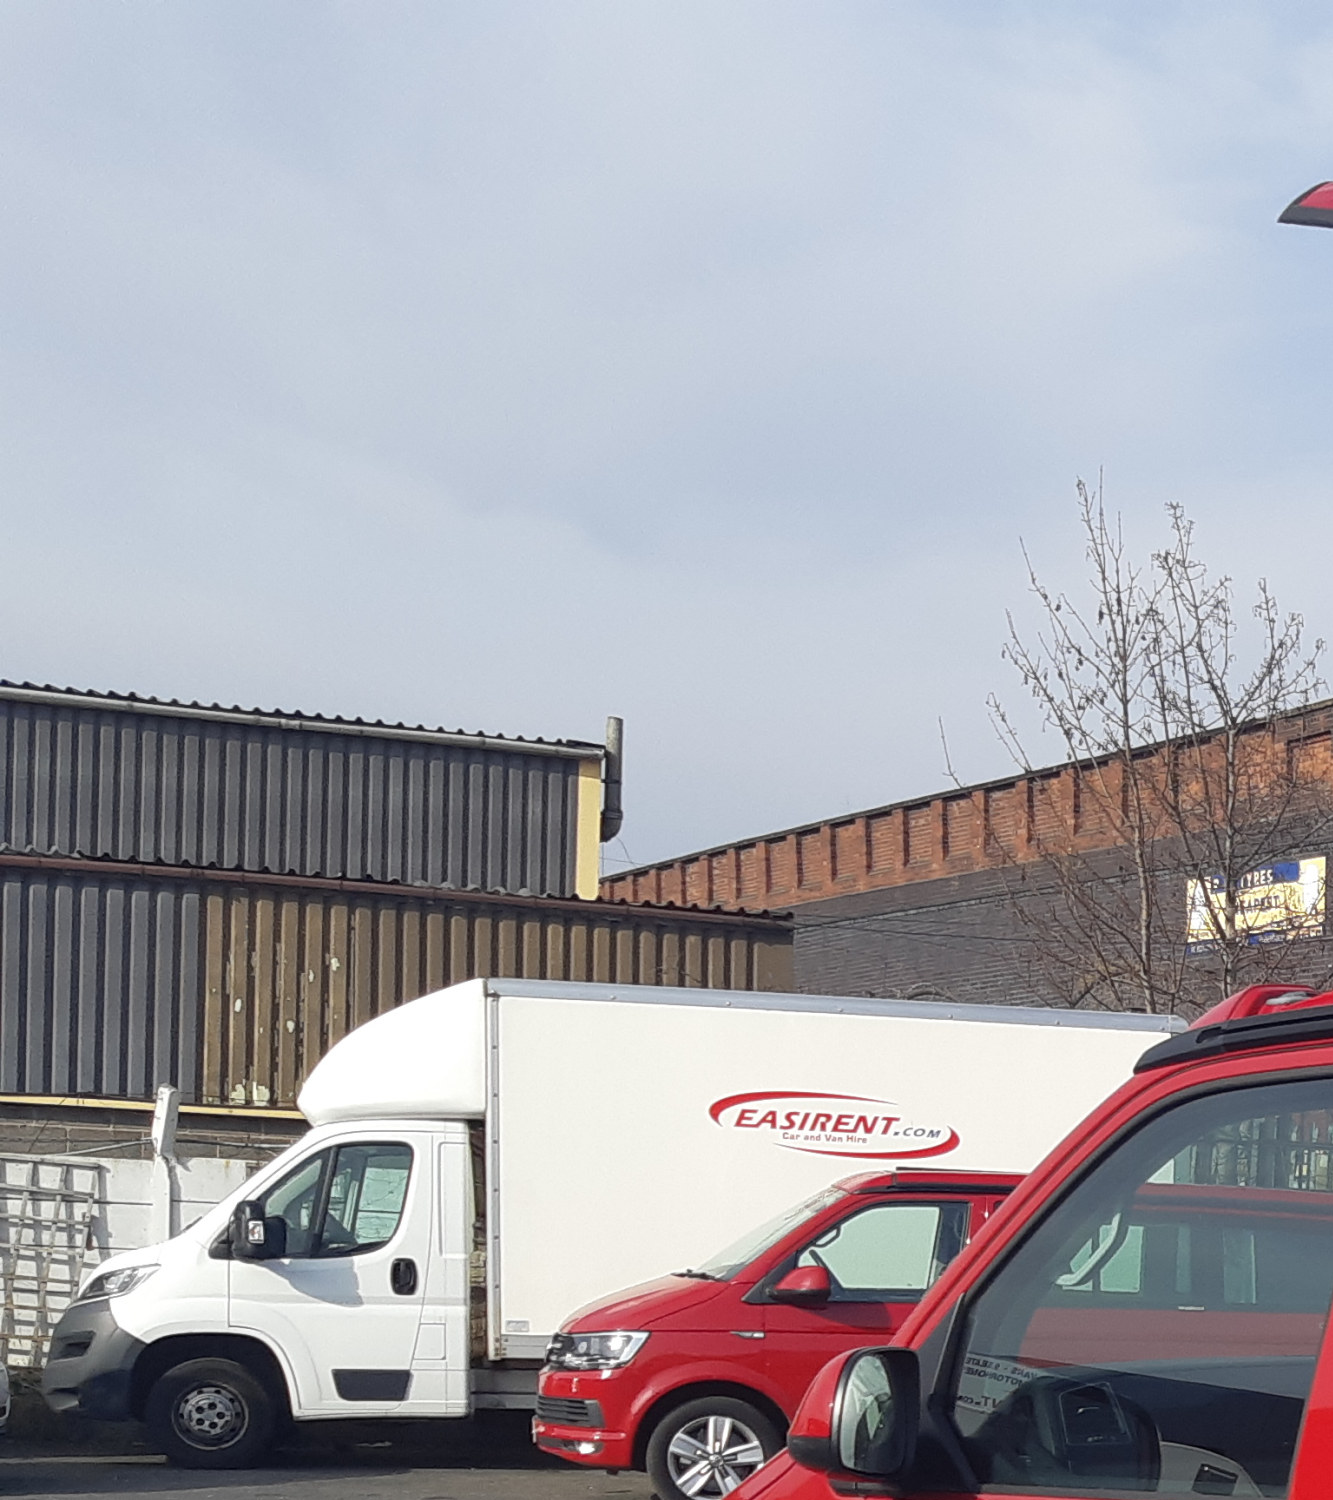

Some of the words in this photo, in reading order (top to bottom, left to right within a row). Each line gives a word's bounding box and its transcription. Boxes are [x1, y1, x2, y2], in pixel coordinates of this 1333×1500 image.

[782, 1132, 801, 1141] Car
[803, 1133, 821, 1142] and
[824, 1134, 843, 1143] Van
[846, 1135, 868, 1144] Hire
